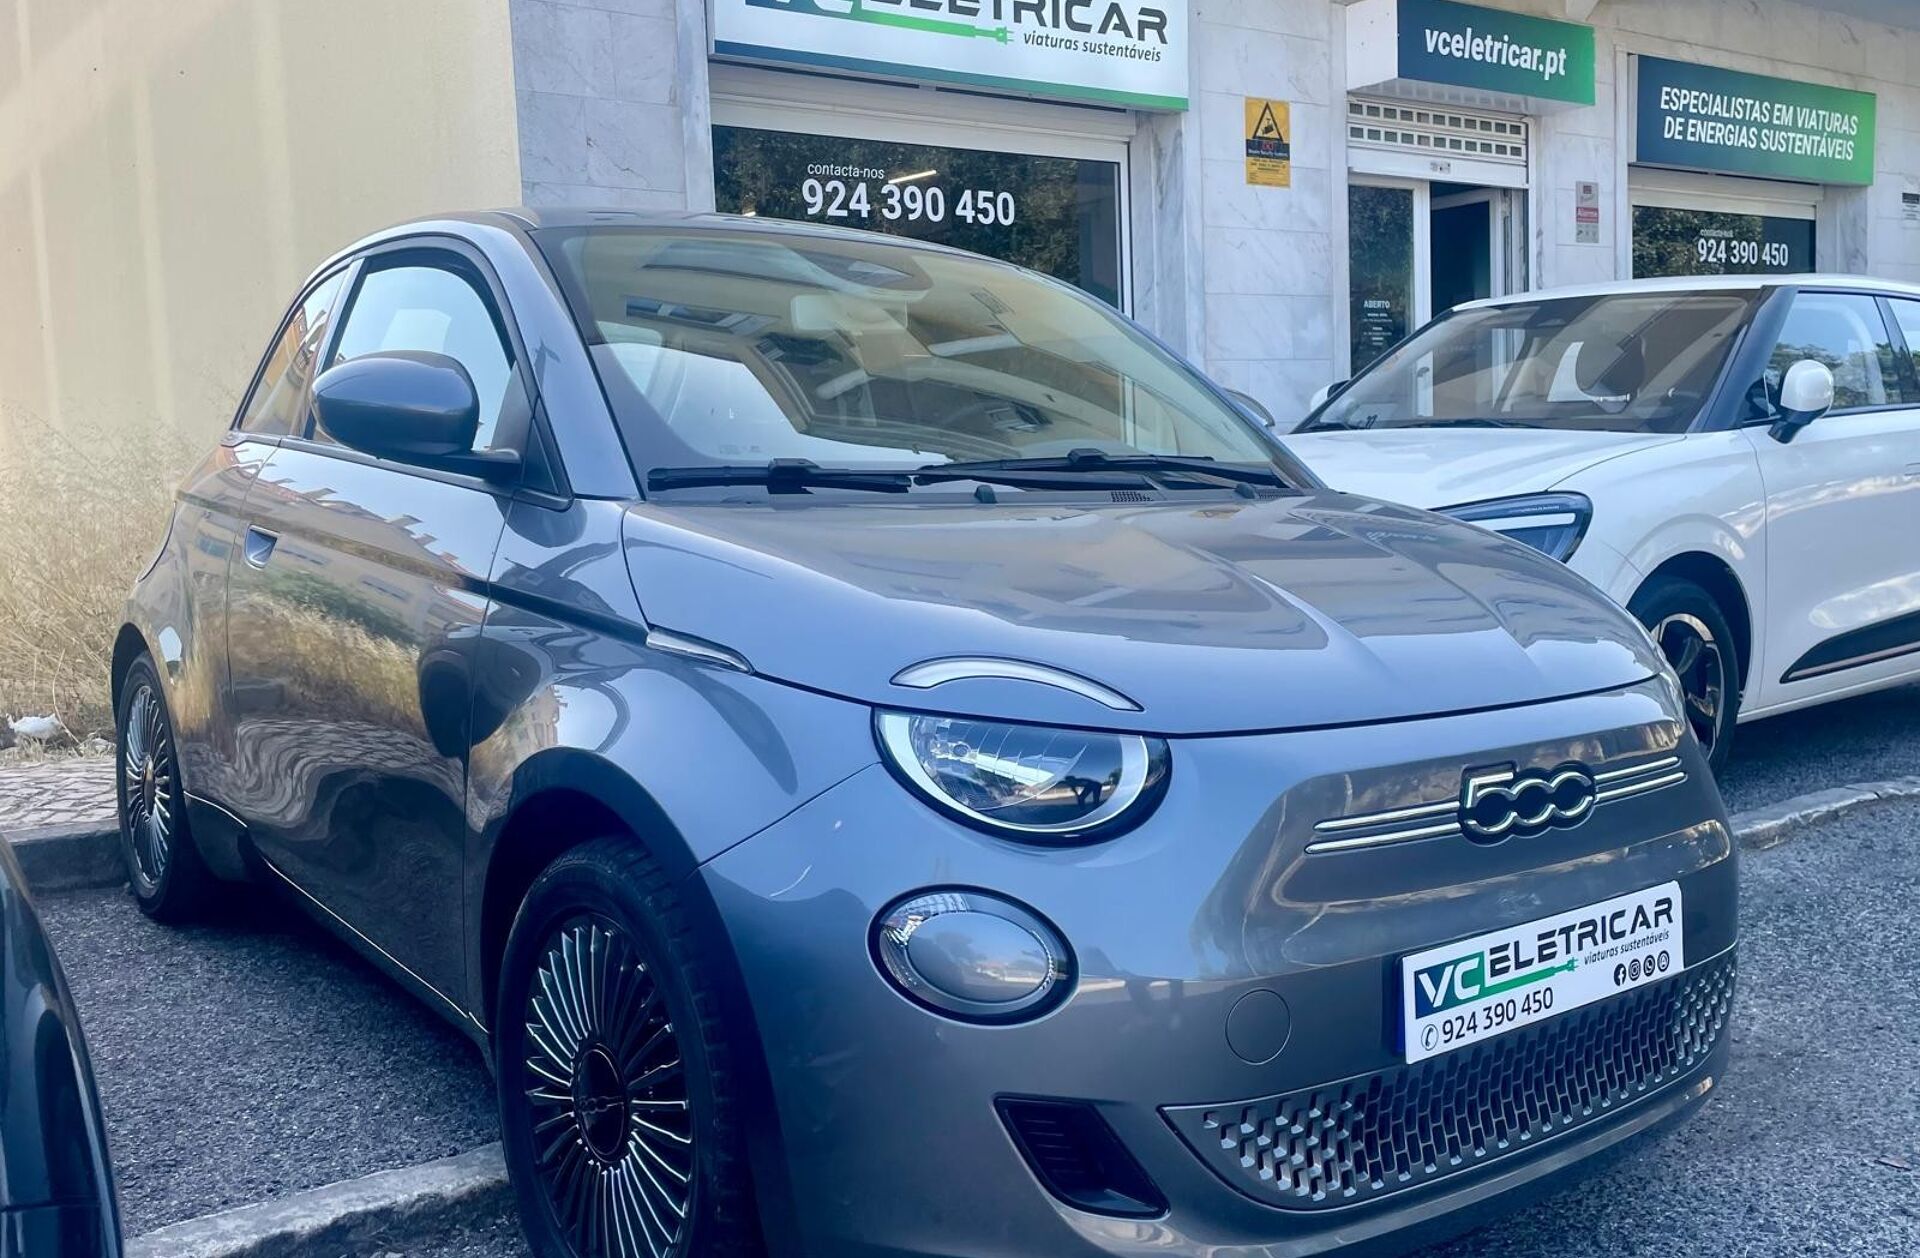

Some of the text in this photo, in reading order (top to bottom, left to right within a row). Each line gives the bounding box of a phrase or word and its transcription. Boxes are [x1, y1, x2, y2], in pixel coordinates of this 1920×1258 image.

[1023, 30, 1161, 62] viaturas sustentáveis
[1424, 26, 1567, 81] vceletricar.pt
[1660, 86, 1859, 136] ESPECIALISTAS EM VIATURAS
[1663, 115, 1855, 161] DE ENERGIAS SUSTENTÁVEIS
[806, 162, 885, 180] contacta-nos
[801, 178, 1015, 226] 924 390 450
[1697, 238, 1789, 266] 924 390 450
[1463, 770, 1594, 835] 500
[1584, 928, 1670, 965] viaturas sustentáveis
[1442, 986, 1554, 1044] 924 390 450
